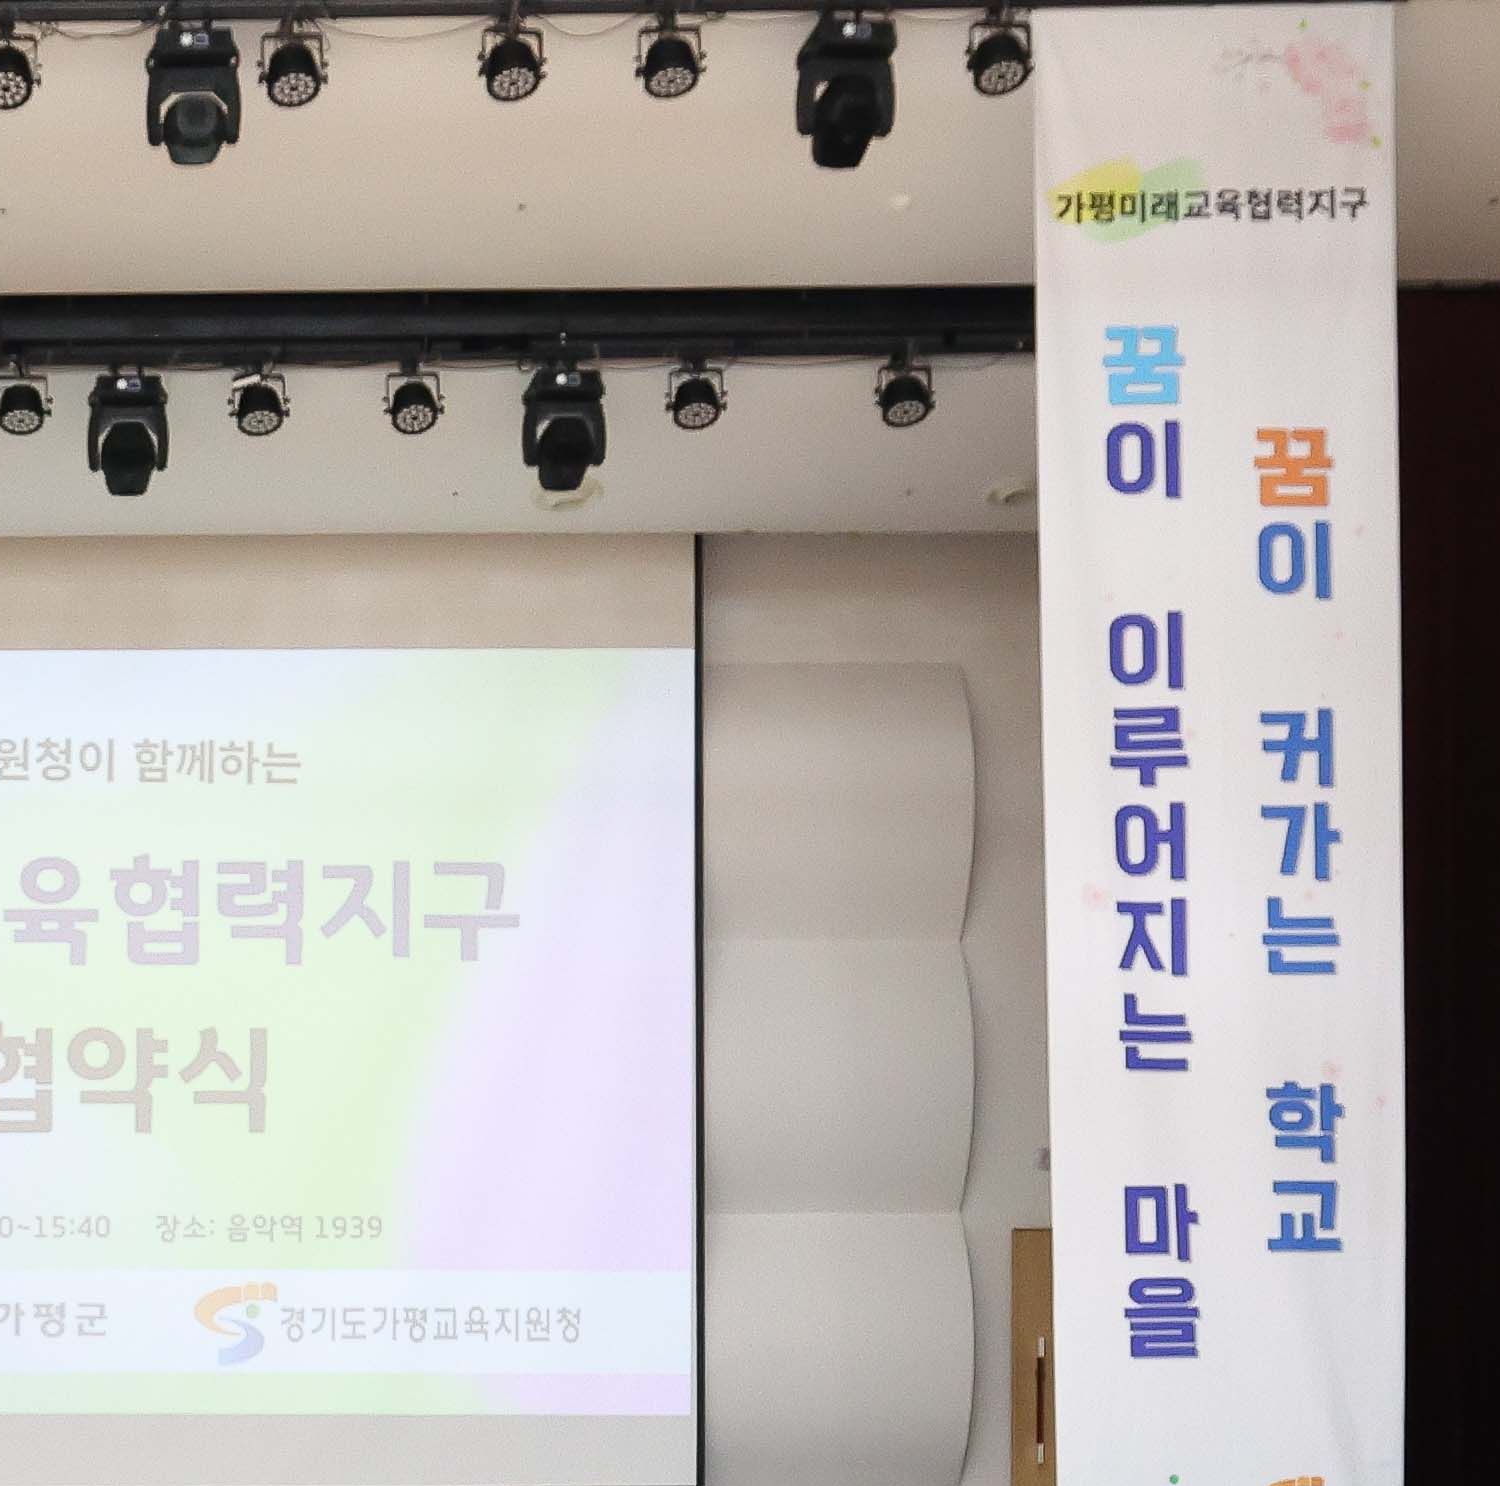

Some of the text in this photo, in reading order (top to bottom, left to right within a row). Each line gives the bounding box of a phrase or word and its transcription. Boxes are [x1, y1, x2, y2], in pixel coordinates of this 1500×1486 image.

[1056, 185, 1370, 224] 가평미래교육협력지구
[134, 739, 302, 785] 함께하는
[1103, 327, 1200, 1358] 꿈이 이루어지는 마을
[1254, 429, 1344, 1252] 꿈이 커가는 학교
[156, 1214, 382, 1243] 장소: 음악역 1939
[281, 1306, 581, 1344] 경기도가평교육지원청
